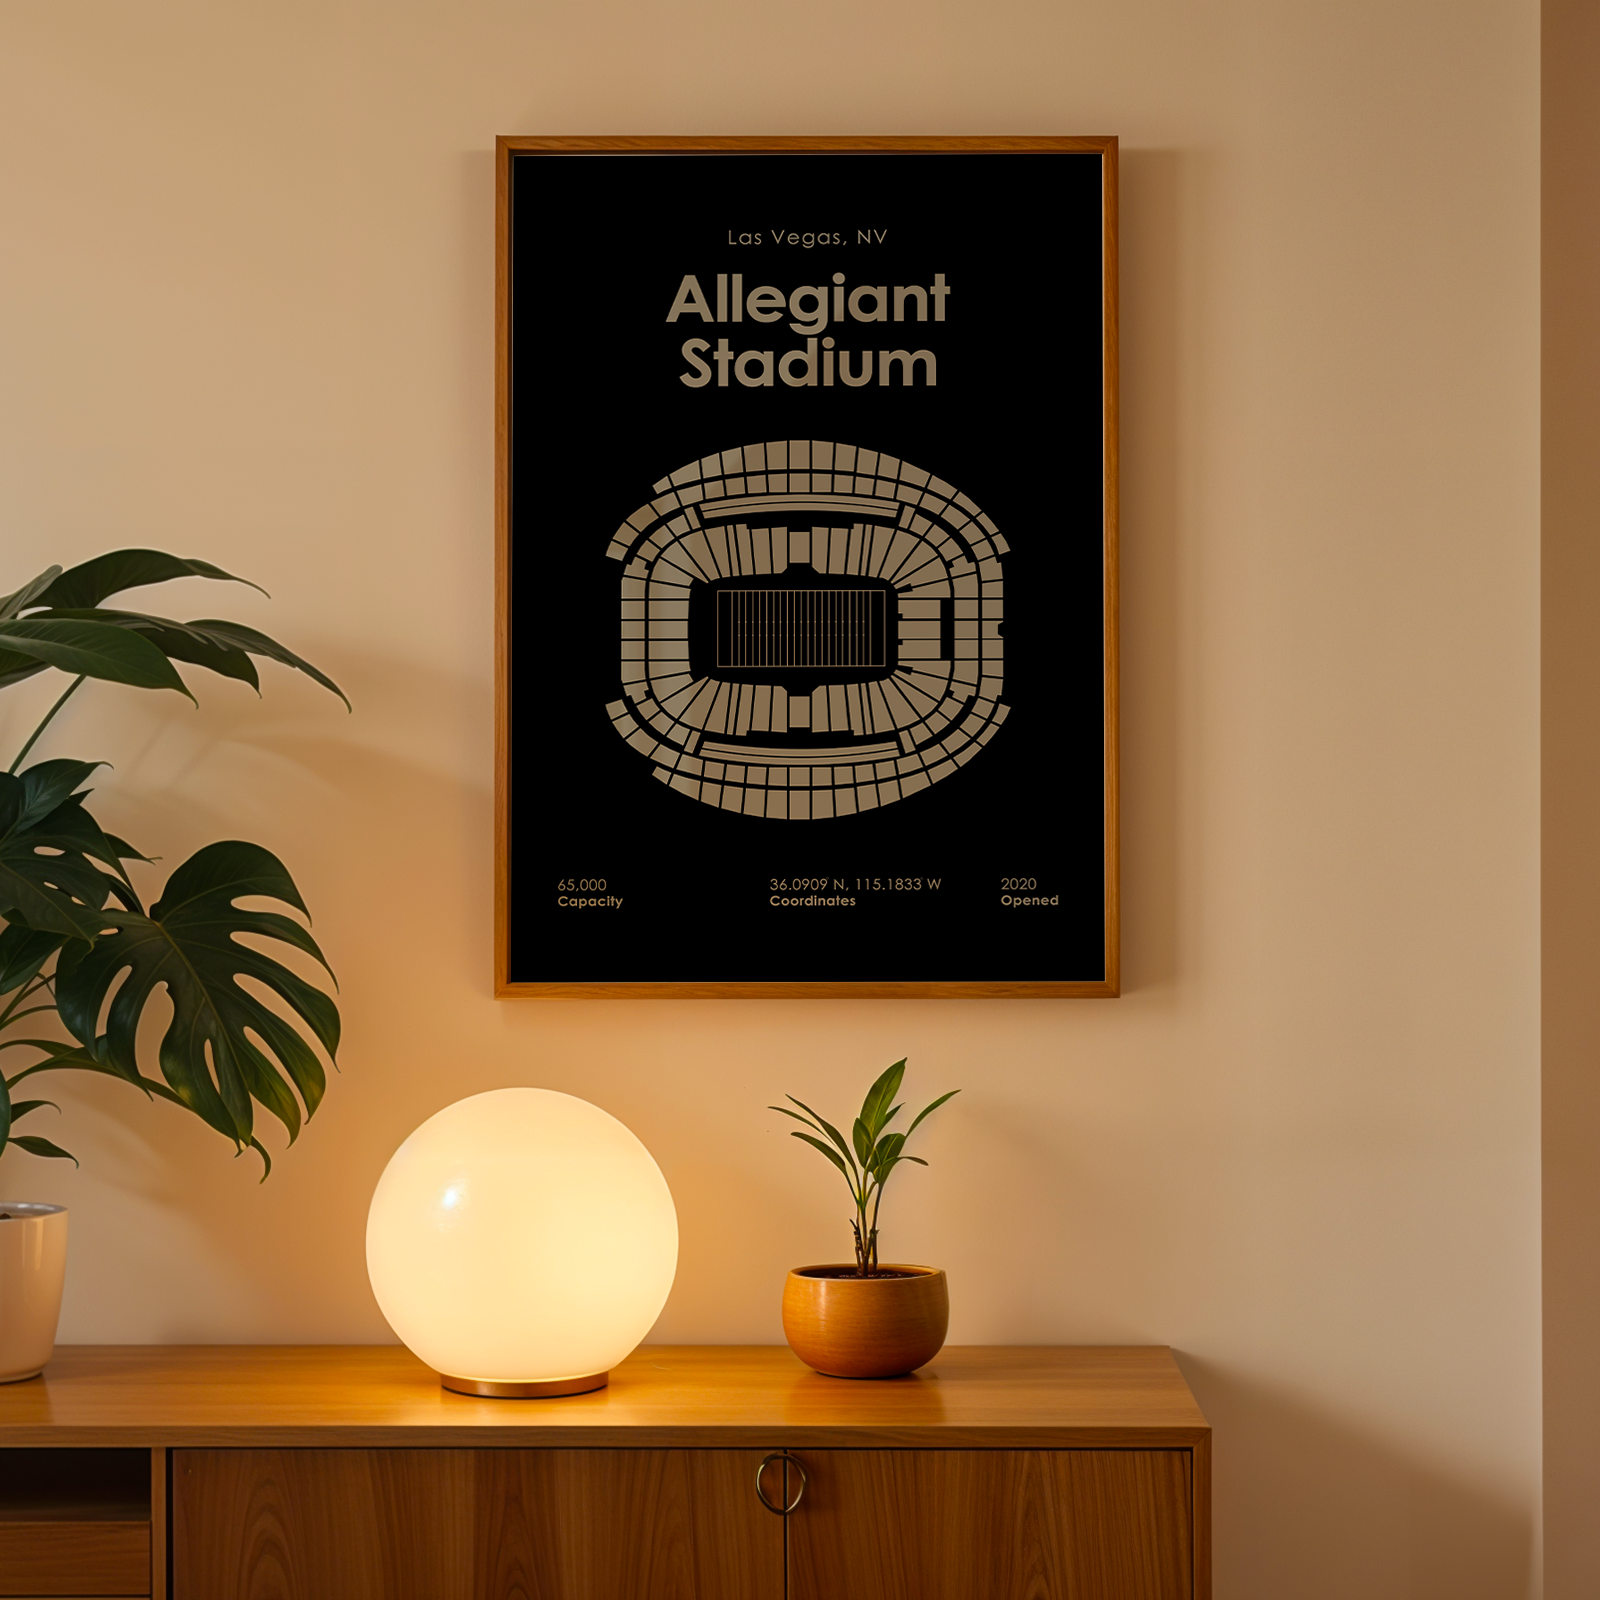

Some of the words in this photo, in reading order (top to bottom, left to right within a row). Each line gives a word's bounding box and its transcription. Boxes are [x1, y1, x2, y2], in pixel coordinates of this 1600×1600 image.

[728, 229, 762, 246] Las
[771, 229, 847, 249] Vegas,
[857, 228, 888, 245] NV
[665, 272, 951, 336] Allegiant
[679, 337, 937, 389] Stadium
[557, 878, 607, 892] 65,000
[833, 878, 850, 892] N,
[926, 878, 942, 891] W
[1000, 877, 1037, 891] 2020
[557, 895, 624, 909] Capacity
[769, 894, 857, 907] Coordinates
[1000, 894, 1059, 909] Opened
